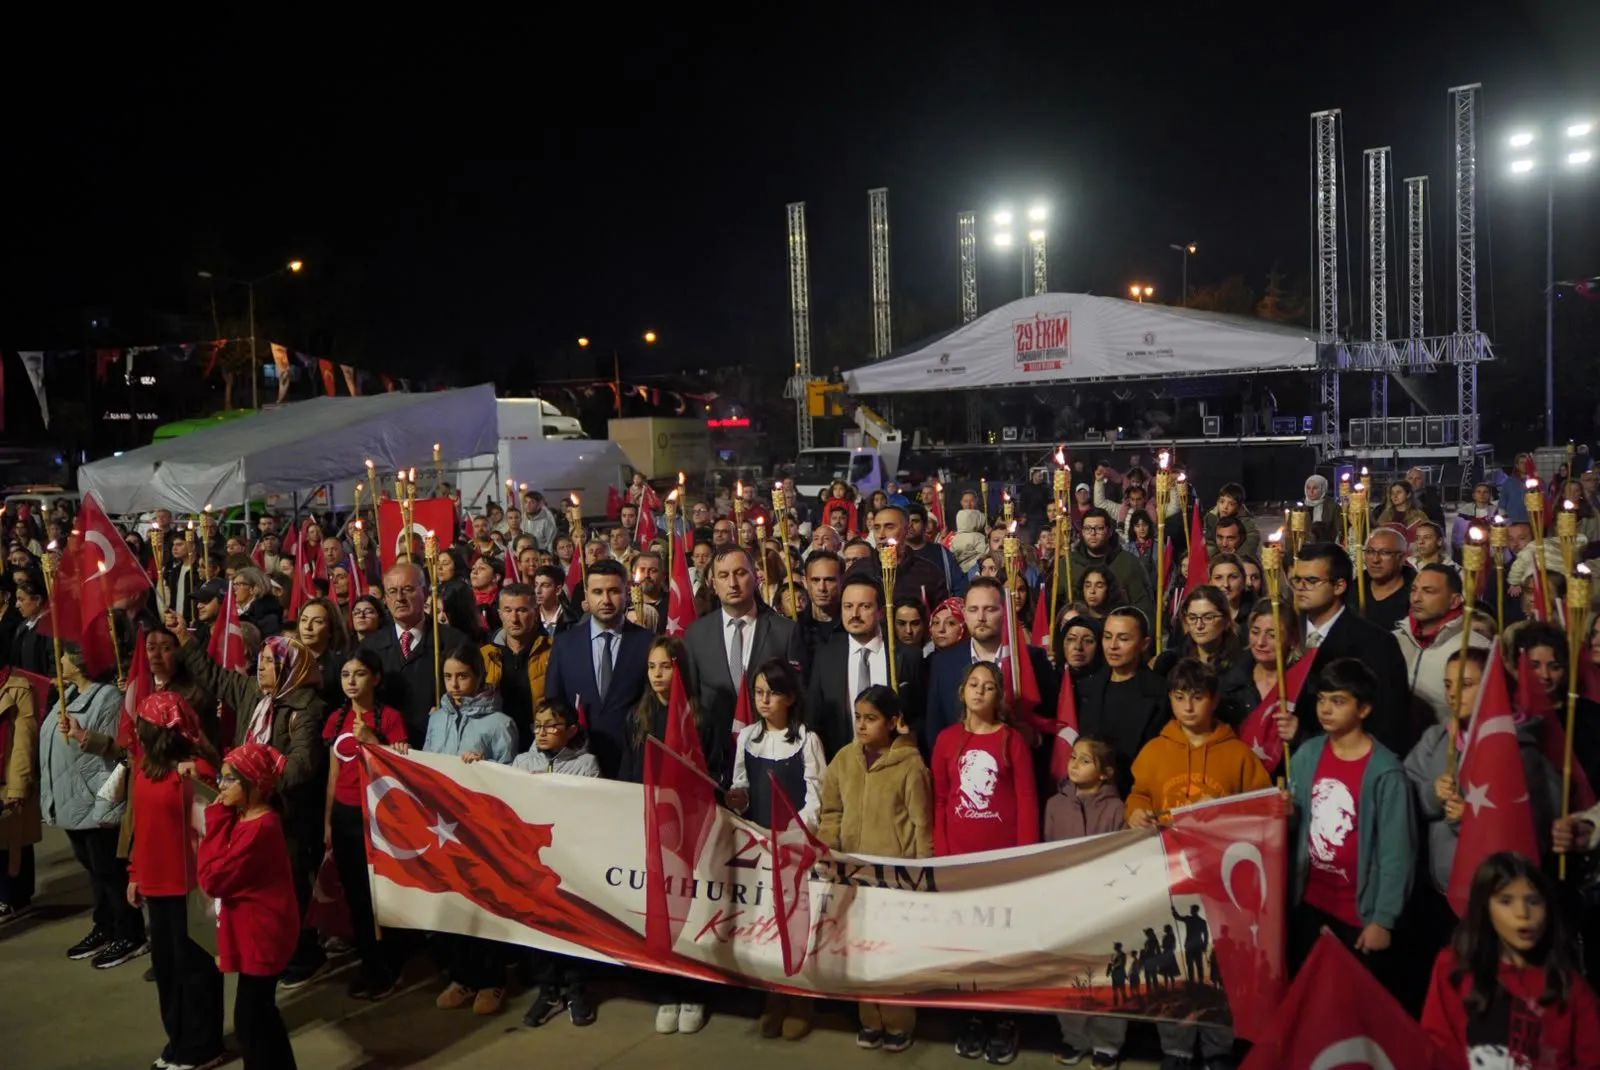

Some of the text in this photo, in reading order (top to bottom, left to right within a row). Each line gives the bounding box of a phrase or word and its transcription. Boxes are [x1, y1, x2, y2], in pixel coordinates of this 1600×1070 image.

[1015, 323, 1033, 351] 29
[605, 866, 1014, 931] CUHURİET AYRAMI
[693, 909, 783, 944] Kutl
